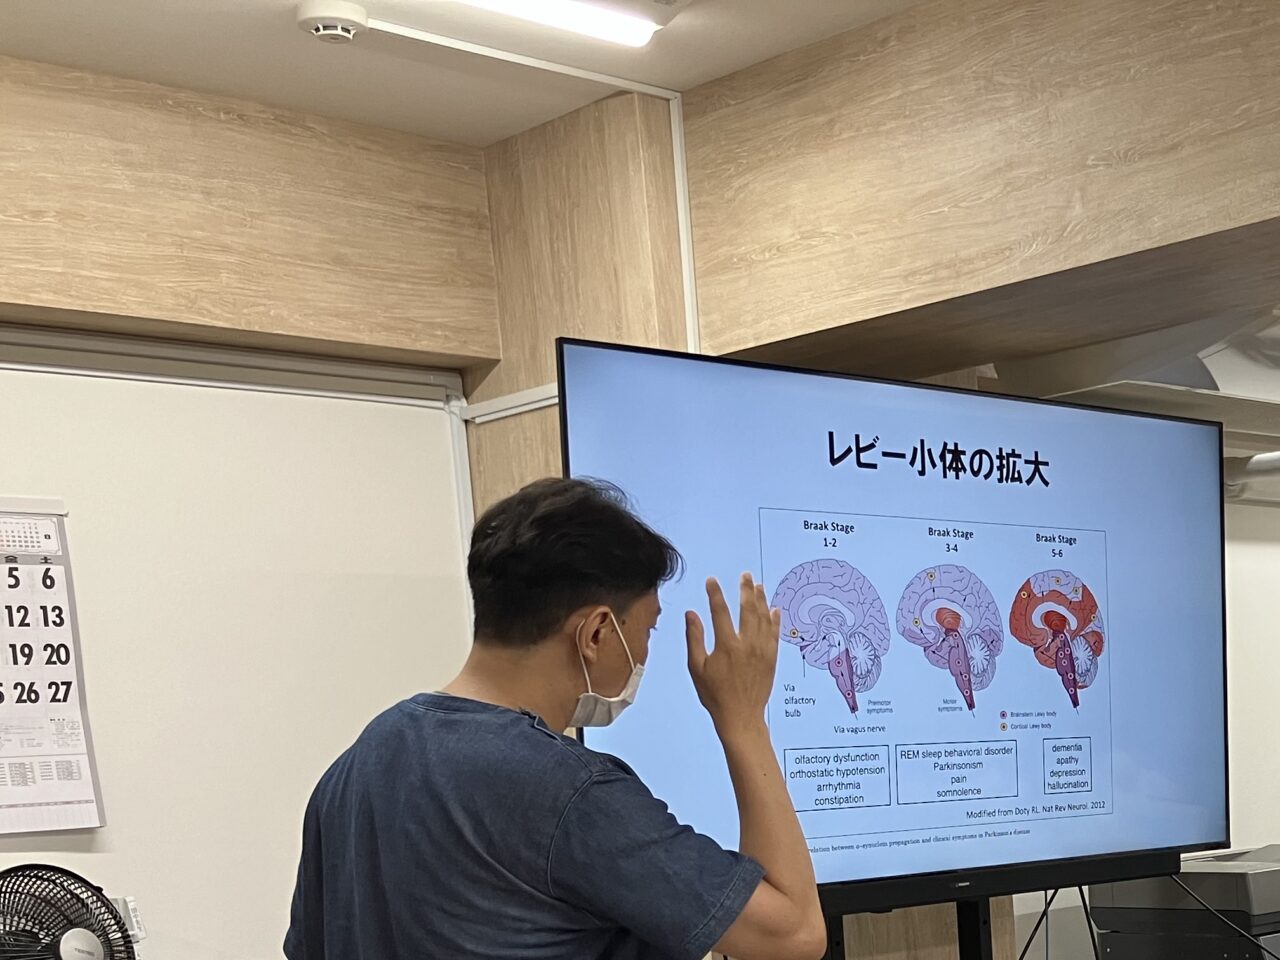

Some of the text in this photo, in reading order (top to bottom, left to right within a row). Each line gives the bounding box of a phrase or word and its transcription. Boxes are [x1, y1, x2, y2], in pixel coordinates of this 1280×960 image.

[828, 430, 1051, 488] レビー小体の拡大
[803, 520, 855, 534] Braak Stage
[928, 527, 974, 540] Braak Stage
[823, 538, 838, 548] 1-2
[1035, 533, 1078, 546] Braak Stage
[945, 543, 959, 554] 3-4
[1051, 548, 1064, 558] 5-6
[7, 566, 56, 590] 5 6
[4, 604, 65, 628] 12 13
[8, 643, 71, 666] 19 20
[12, 681, 73, 705] 26 27
[784, 684, 796, 692] Via
[784, 696, 817, 706] olfactory
[785, 709, 801, 718] bulb
[834, 725, 886, 735] Via vagus nerve
[900, 746, 1013, 760] REM sleep behavioral disorder
[1051, 743, 1083, 753] dementia
[795, 752, 880, 765] olfactory dysfunction
[1056, 756, 1079, 765] apathy
[933, 761, 984, 771] Parkinsonism
[790, 766, 886, 779] orthostatic hypotension
[1049, 769, 1086, 779] depression
[951, 775, 967, 785] pain
[1047, 780, 1089, 790] hallucination
[816, 782, 861, 793] arrhythmia
[936, 788, 982, 798] somnolence
[814, 794, 865, 807] constipation
[966, 810, 997, 820] Modified
[997, 808, 1014, 817] from
[1014, 807, 1030, 817] Doty
[1042, 805, 1054, 813] Nat
[1055, 804, 1067, 812] Rev
[1091, 801, 1106, 809] 2012
